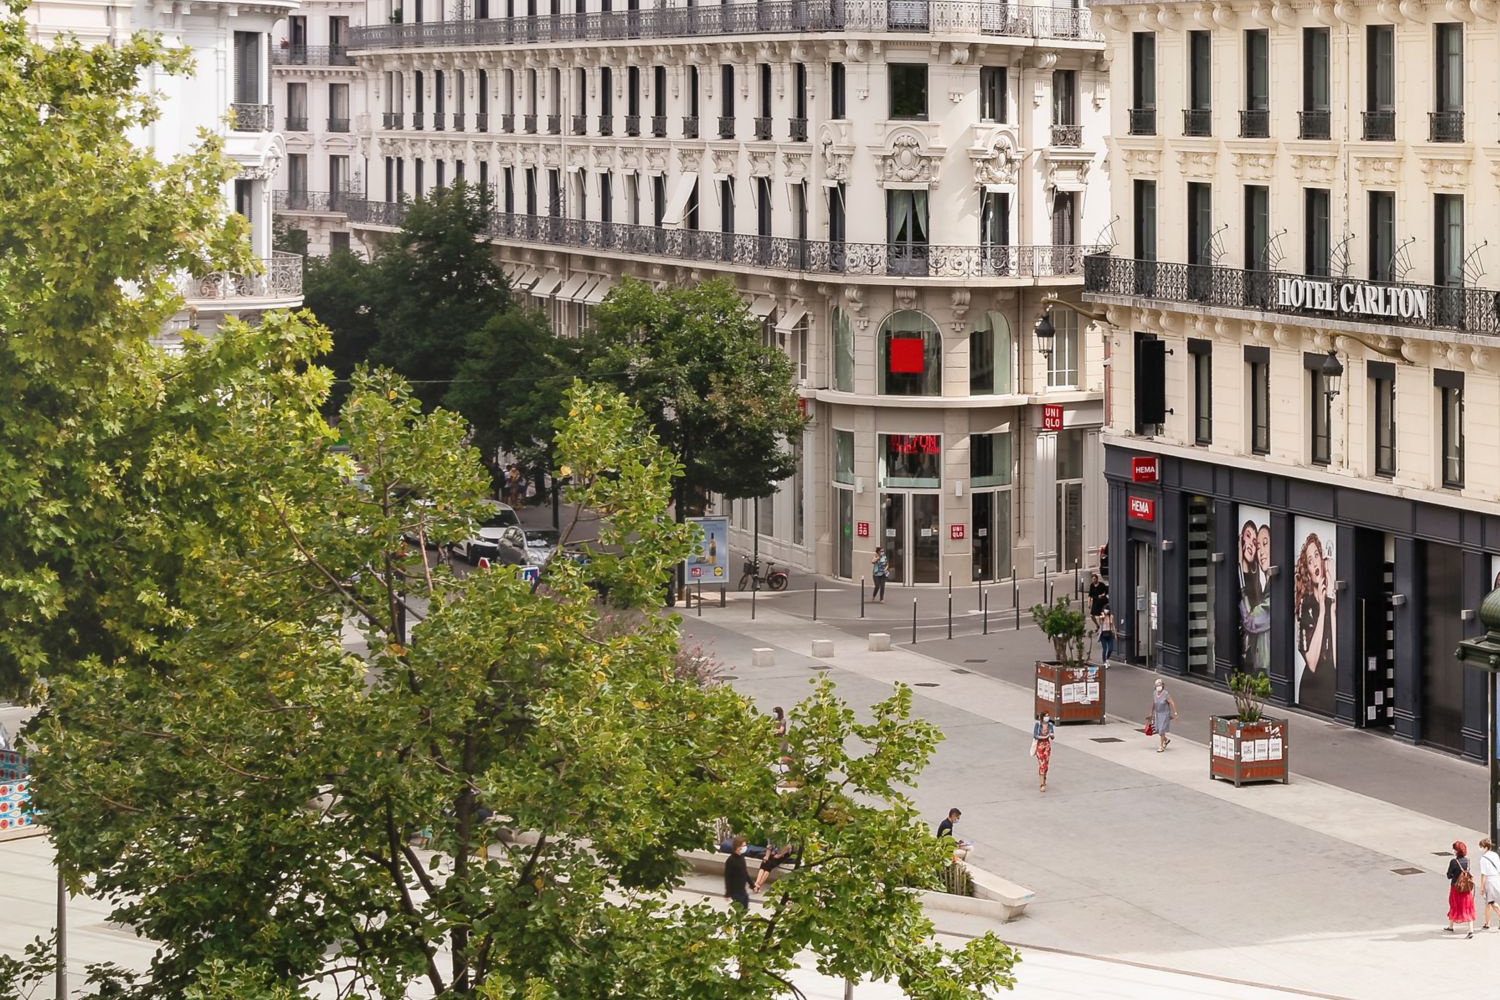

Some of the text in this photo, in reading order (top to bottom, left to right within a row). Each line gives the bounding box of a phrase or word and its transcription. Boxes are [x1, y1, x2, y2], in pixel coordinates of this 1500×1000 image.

[1278, 277, 1429, 320] HOTEL CARLTON
[1045, 407, 1059, 418] UNI
[1045, 418, 1060, 428] QLO
[1135, 466, 1155, 474] HEMA
[1131, 499, 1149, 514] HEMA
